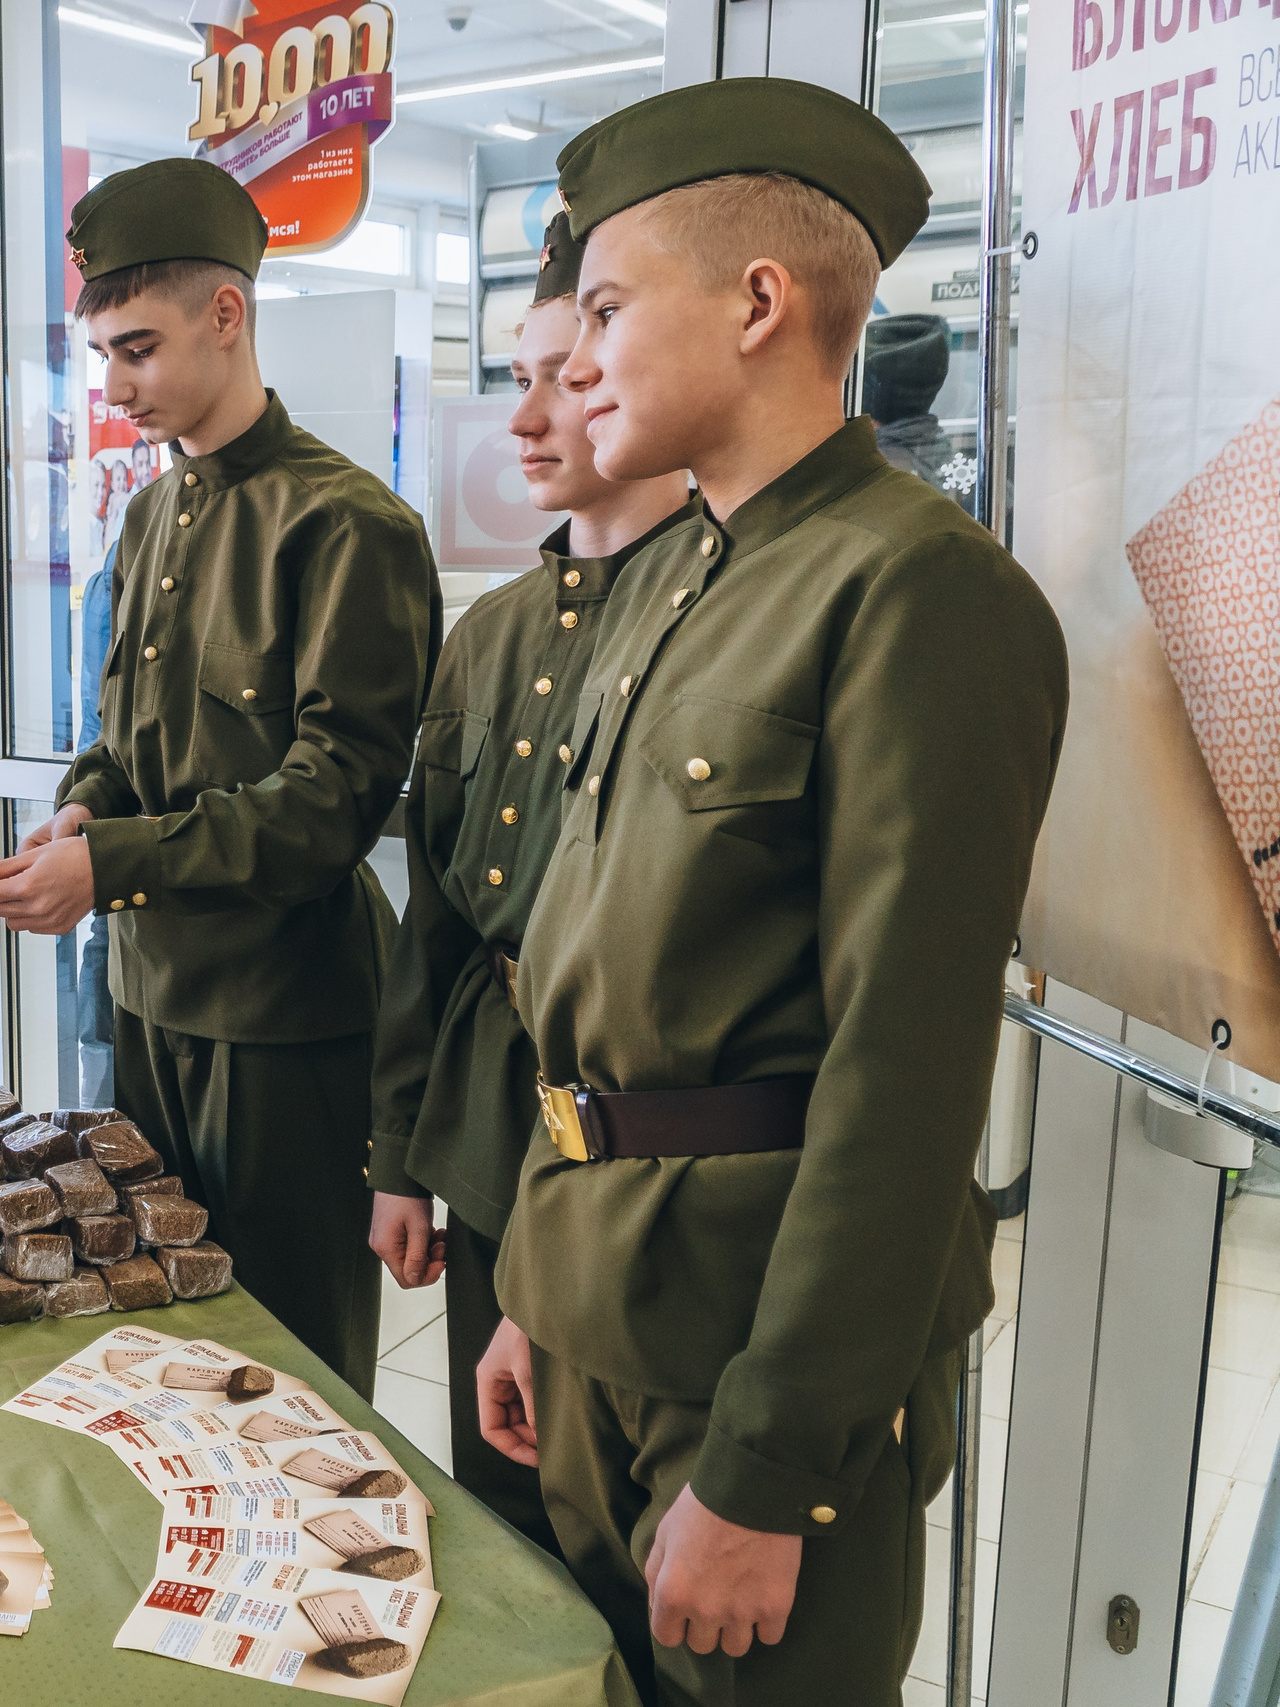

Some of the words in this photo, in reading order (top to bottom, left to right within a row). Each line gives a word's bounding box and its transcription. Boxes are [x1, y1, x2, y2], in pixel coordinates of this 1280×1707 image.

[320, 97, 336, 120] 10
[340, 86, 375, 112] ЛЕТ
[220, 139, 262, 169] ТРУДНИКОВ
[263, 112, 303, 143] РАБОТАЮТ
[260, 130, 291, 157] БОЛЬШЕ
[1067, 67, 1218, 214] ХЛЕБ
[1239, 47, 1280, 108] ВС
[308, 159, 347, 171] работает
[326, 150, 336, 158] из
[338, 148, 353, 156] них
[292, 173, 312, 182] этом
[313, 168, 353, 180] магазине
[269, 220, 300, 237] мся!
[389, 1588, 405, 1604] ХЛЕБ
[351, 1604, 374, 1635] КАРТОЧКА
[395, 1591, 419, 1629] БЛОКАДНЫЙ
